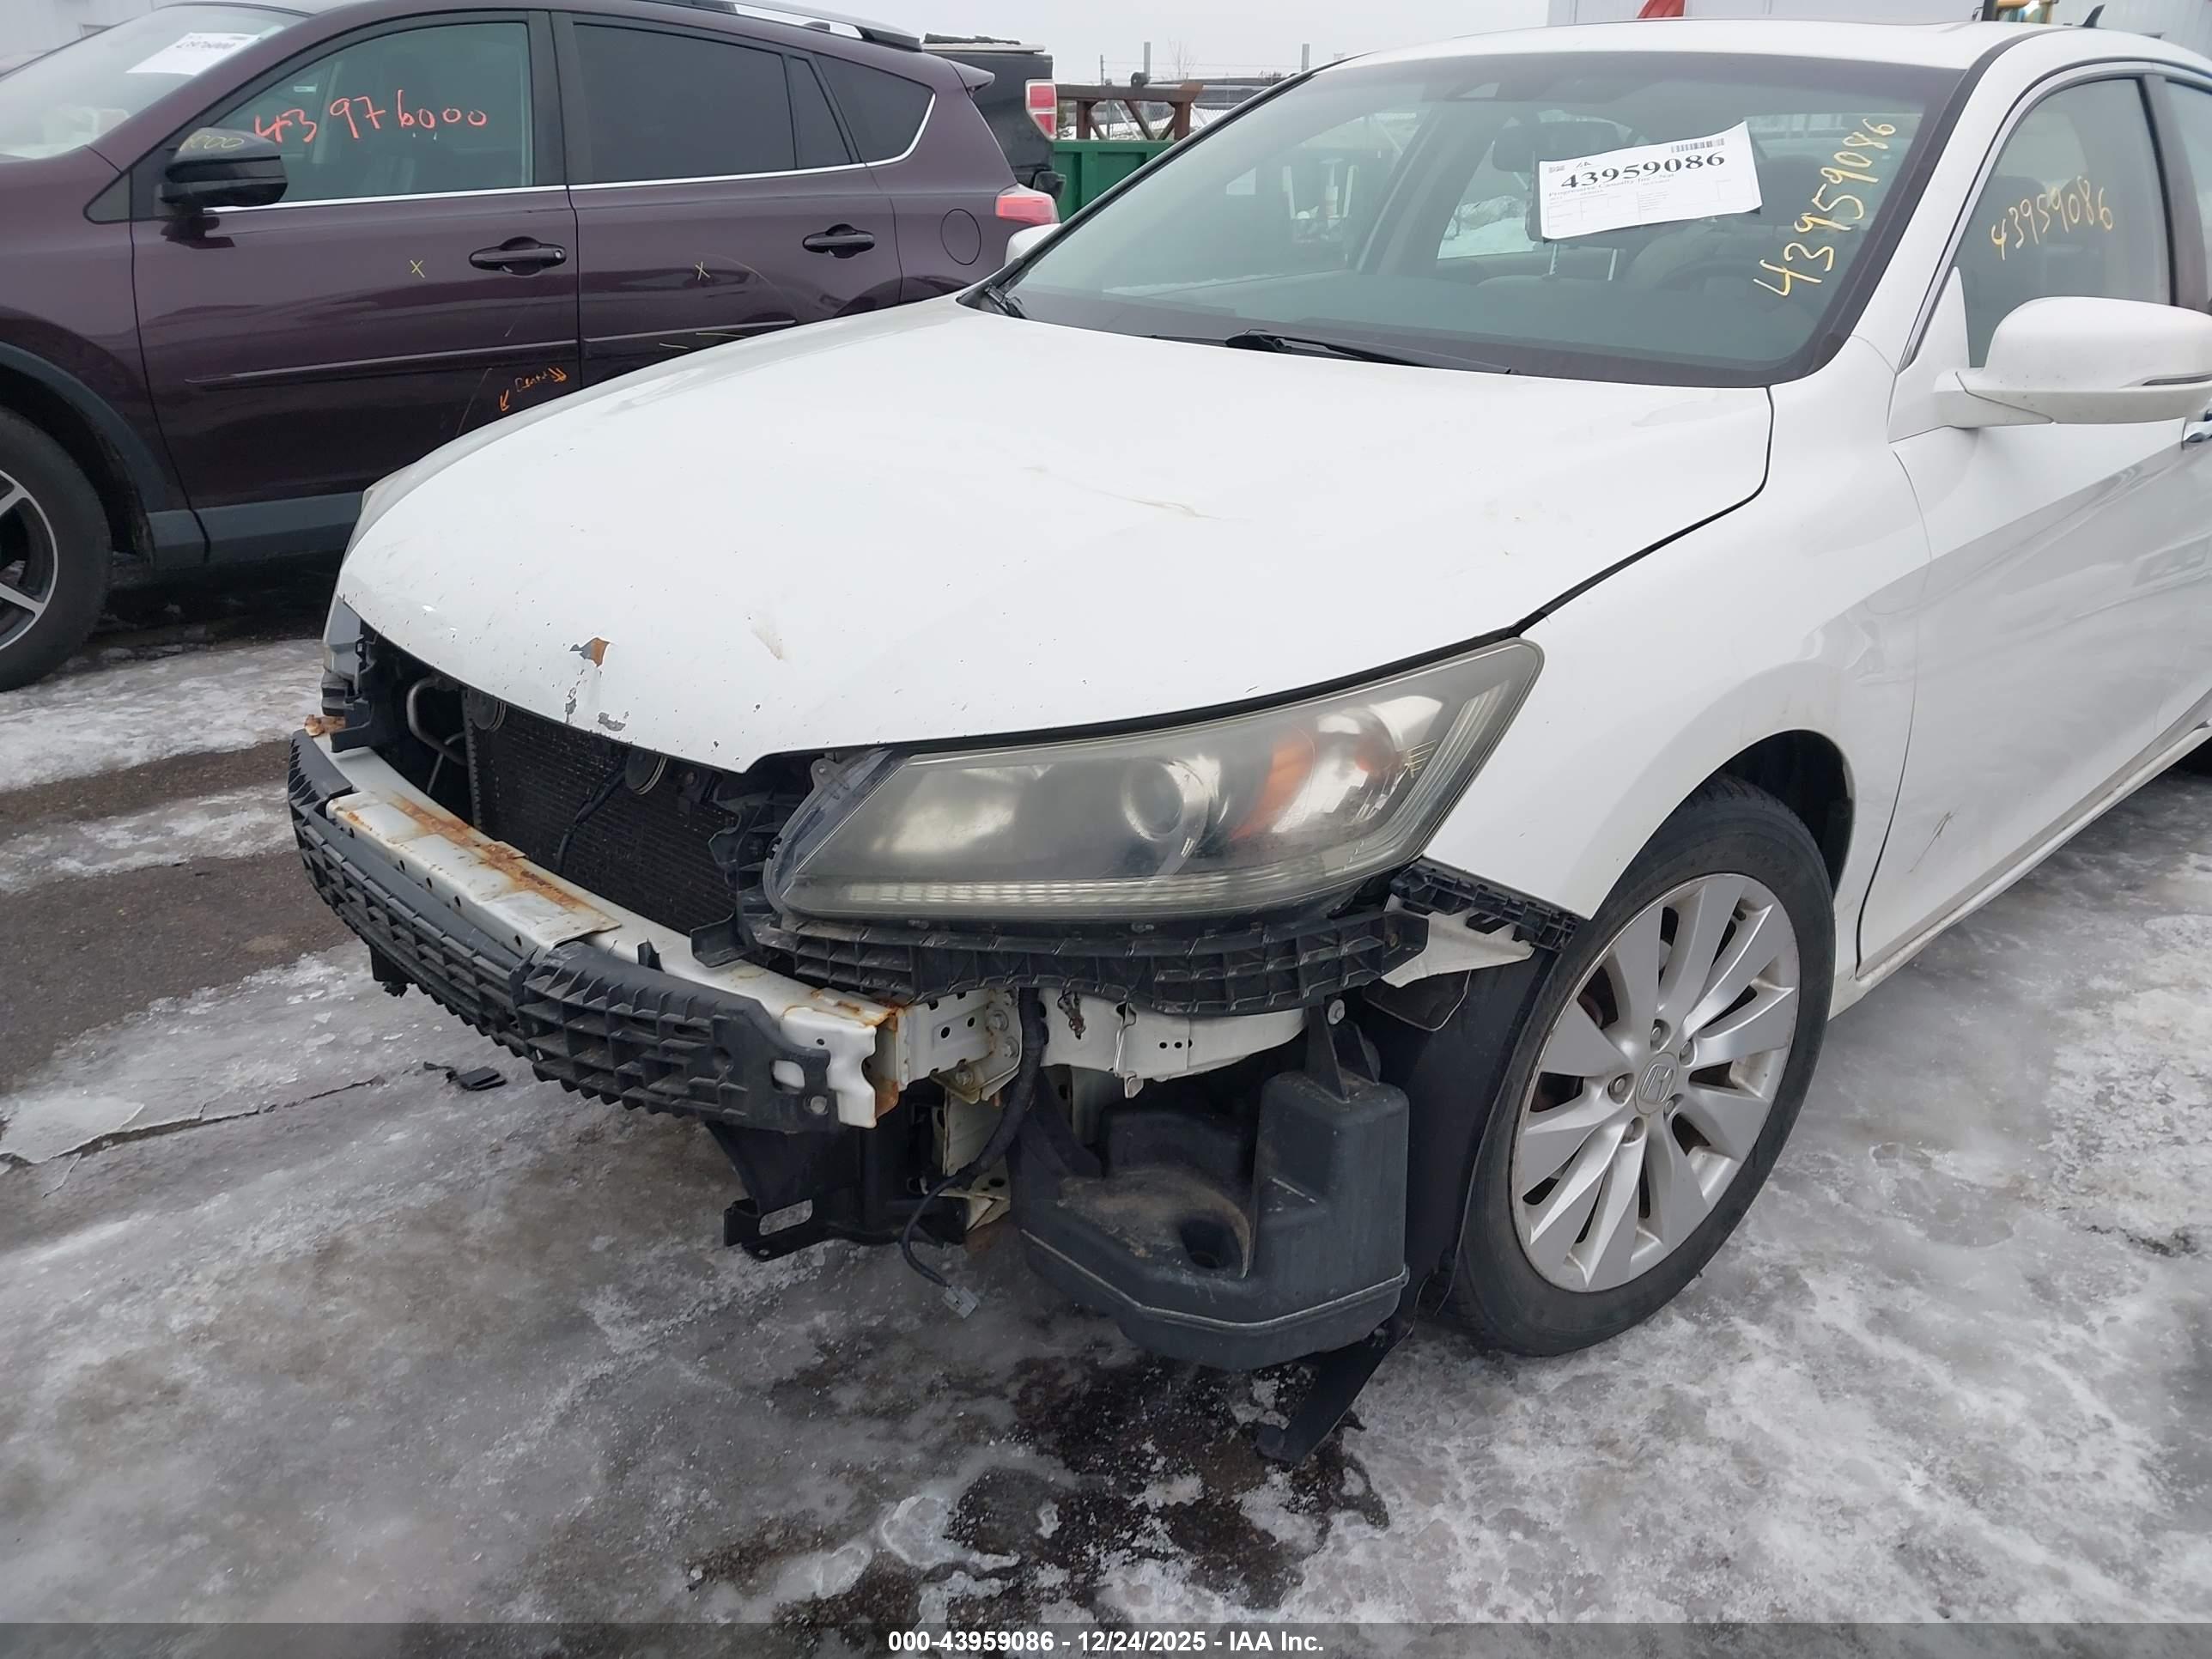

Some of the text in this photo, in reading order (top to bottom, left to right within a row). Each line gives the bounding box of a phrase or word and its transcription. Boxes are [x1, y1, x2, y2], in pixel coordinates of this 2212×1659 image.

[1560, 151, 1725, 189] 43959086
[1753, 118, 1896, 296] 43959086
[1991, 175, 2113, 261] 43959086
